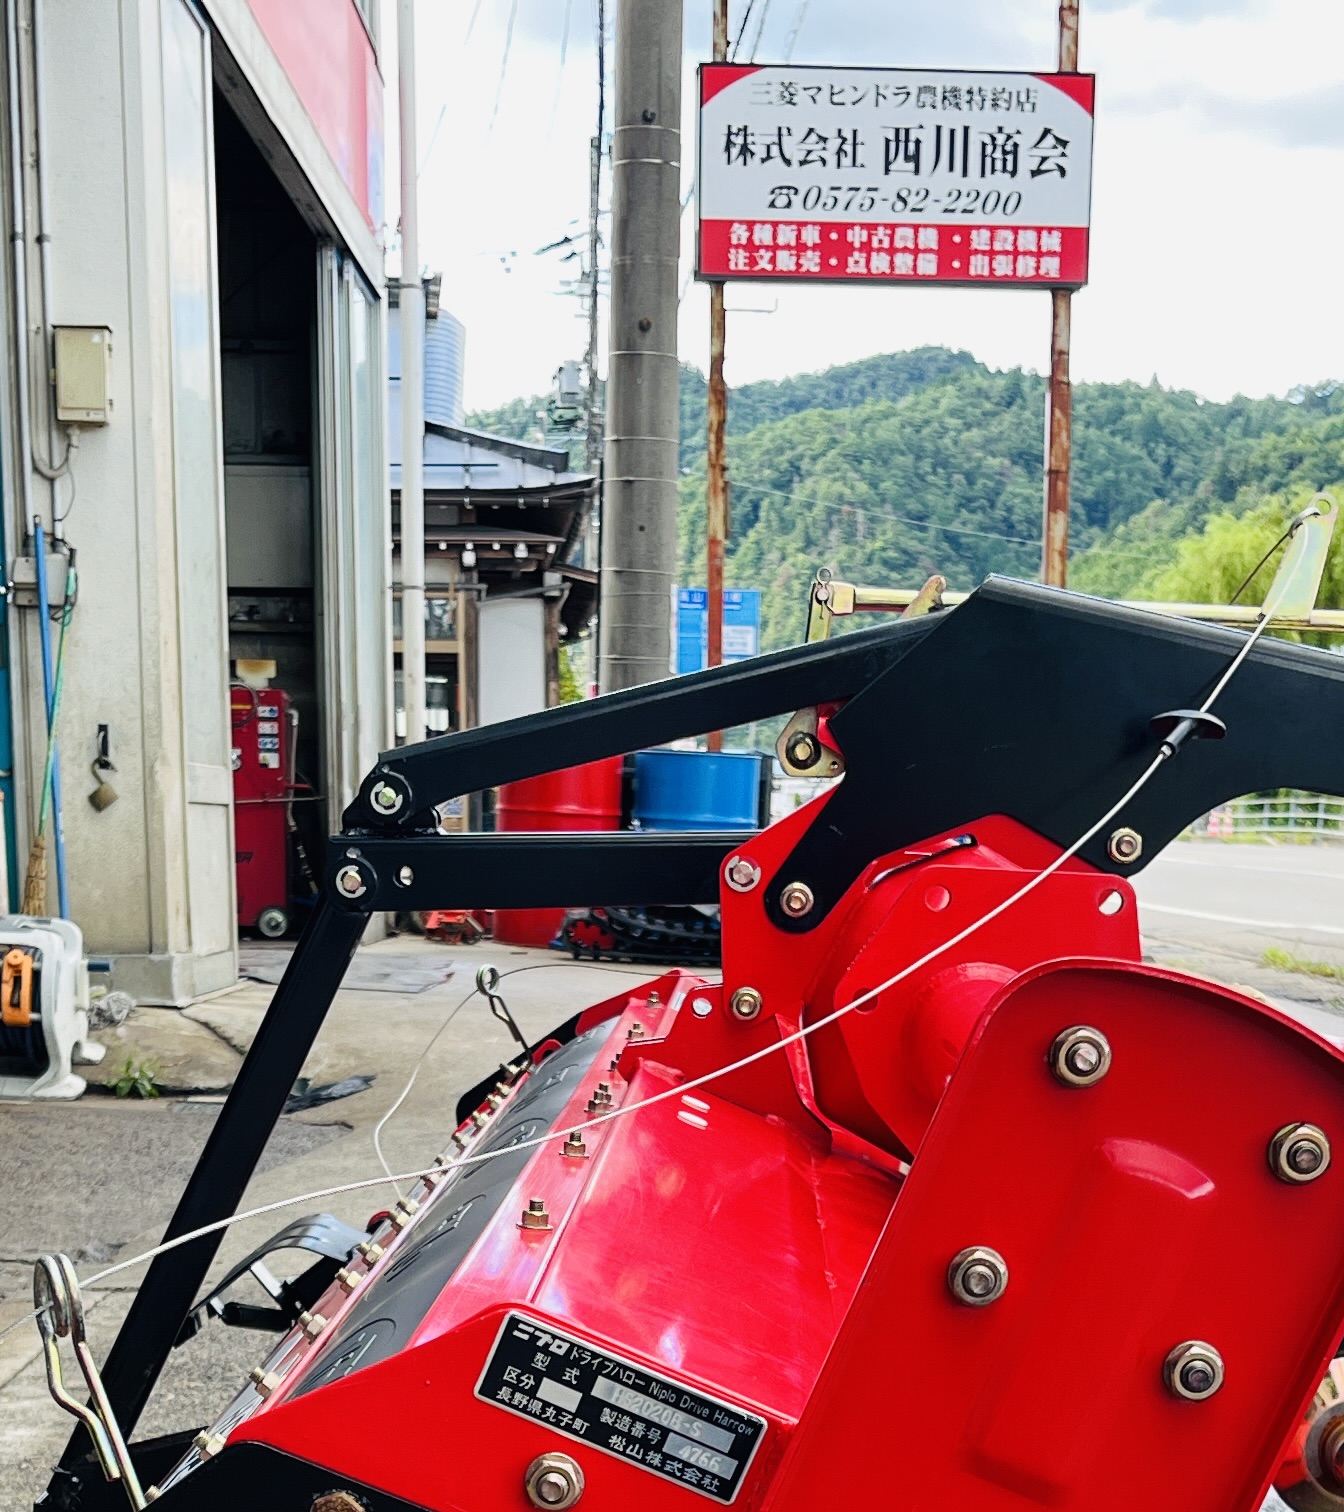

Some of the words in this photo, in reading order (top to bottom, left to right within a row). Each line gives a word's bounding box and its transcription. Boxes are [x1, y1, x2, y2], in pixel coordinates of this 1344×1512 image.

[749, 81, 1038, 113] 三菱マヒンドラ農機特約店
[723, 124, 866, 169] 株式会社
[880, 123, 1071, 179] 西川商会
[802, 185, 1022, 216] 0575-82-2200
[502, 1365, 536, 1390] 区分
[599, 1407, 662, 1445] 製造番号
[648, 1381, 677, 1404] Niplo
[679, 1395, 710, 1419] Drive
[712, 1408, 754, 1437] Harrow
[495, 1385, 591, 1435] 長野県丸子町
[608, 1434, 721, 1493] 松山株式会社
